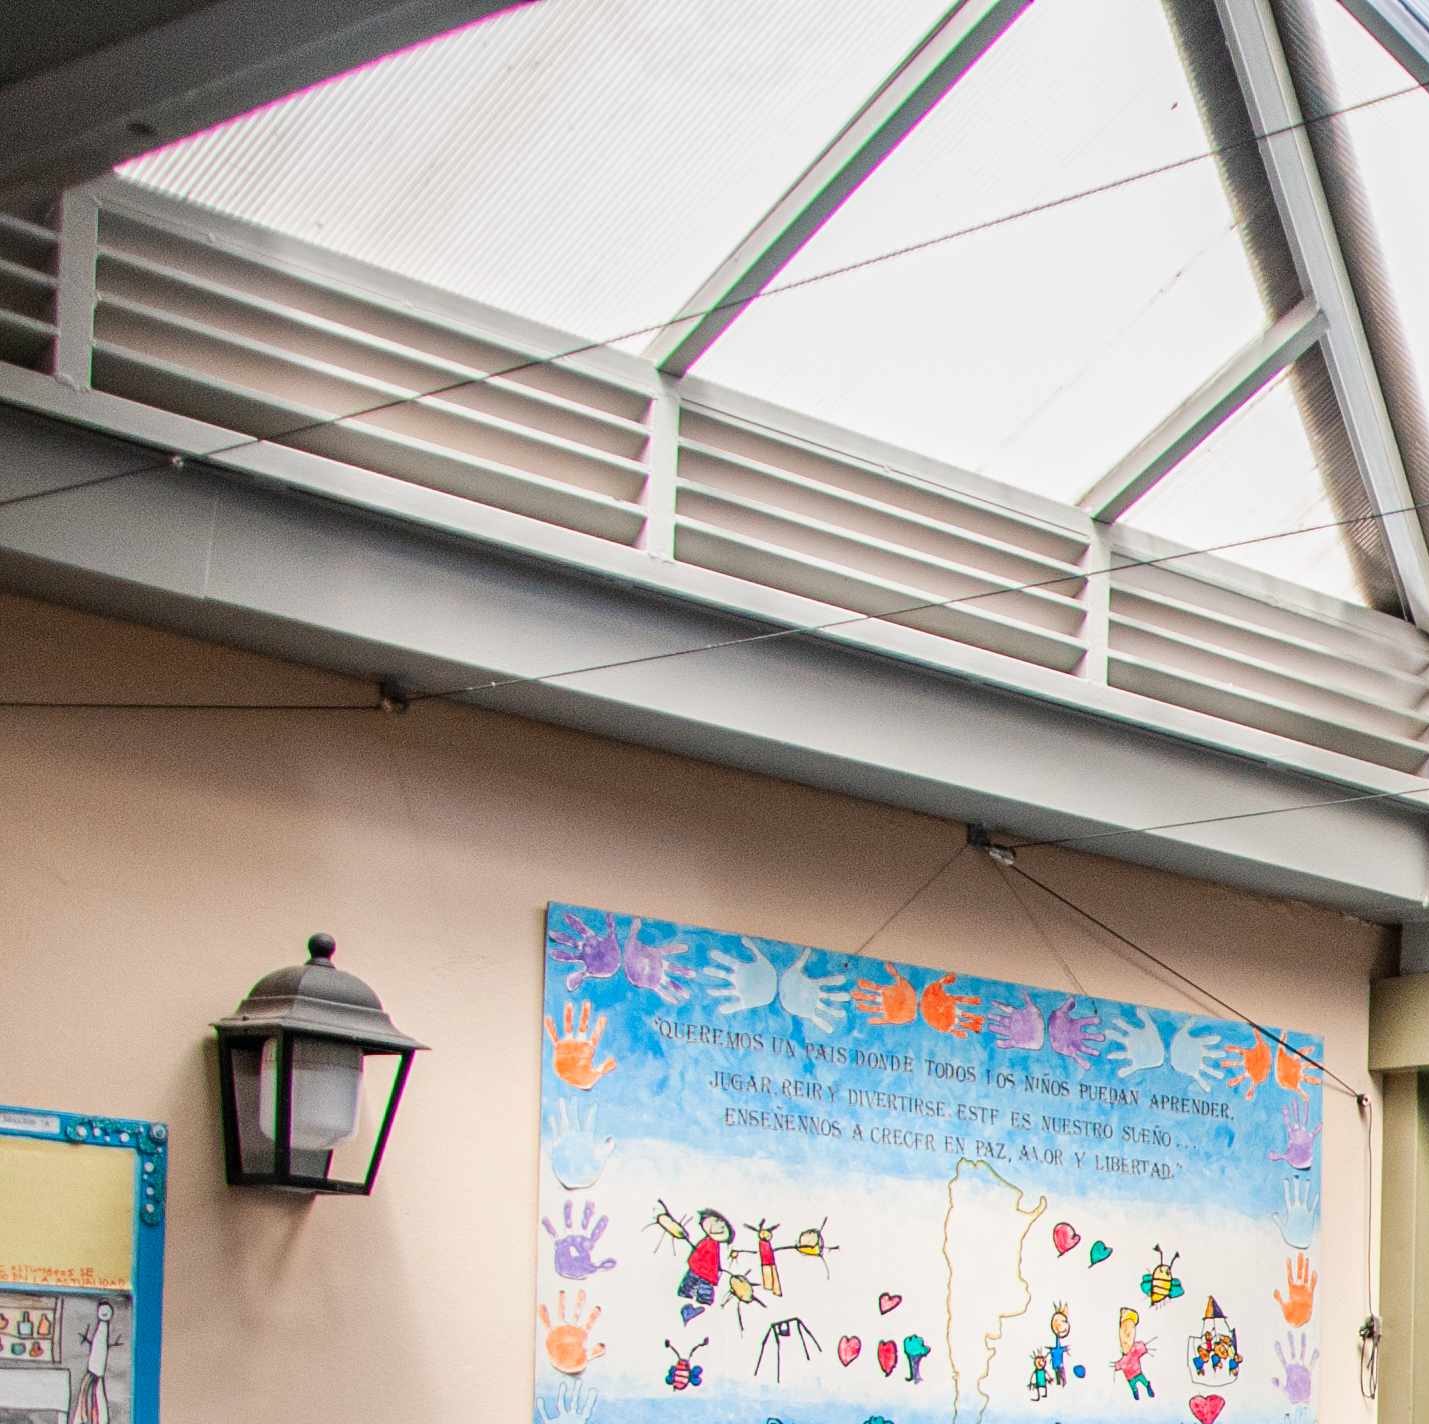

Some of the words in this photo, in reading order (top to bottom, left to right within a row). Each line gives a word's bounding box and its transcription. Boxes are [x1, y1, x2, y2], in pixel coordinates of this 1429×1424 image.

[772, 1036, 796, 1057] UN
[856, 1049, 914, 1073] DONDE
[925, 1059, 976, 1082] TODOS
[1024, 1073, 1070, 1097] NIÑOS
[1079, 1083, 1139, 1106] PUEDAN
[725, 1104, 842, 1137] ENSEÑENNOS
[852, 1124, 864, 1141] A
[871, 1127, 936, 1152] CRECER
[945, 1135, 965, 1154] EN
[1074, 1152, 1086, 1168] Y
[781, 1078, 822, 1100] REIR
[827, 1085, 838, 1103] Y
[1011, 1111, 1032, 1131] ES
[1041, 1115, 1114, 1140] NUESTRO
